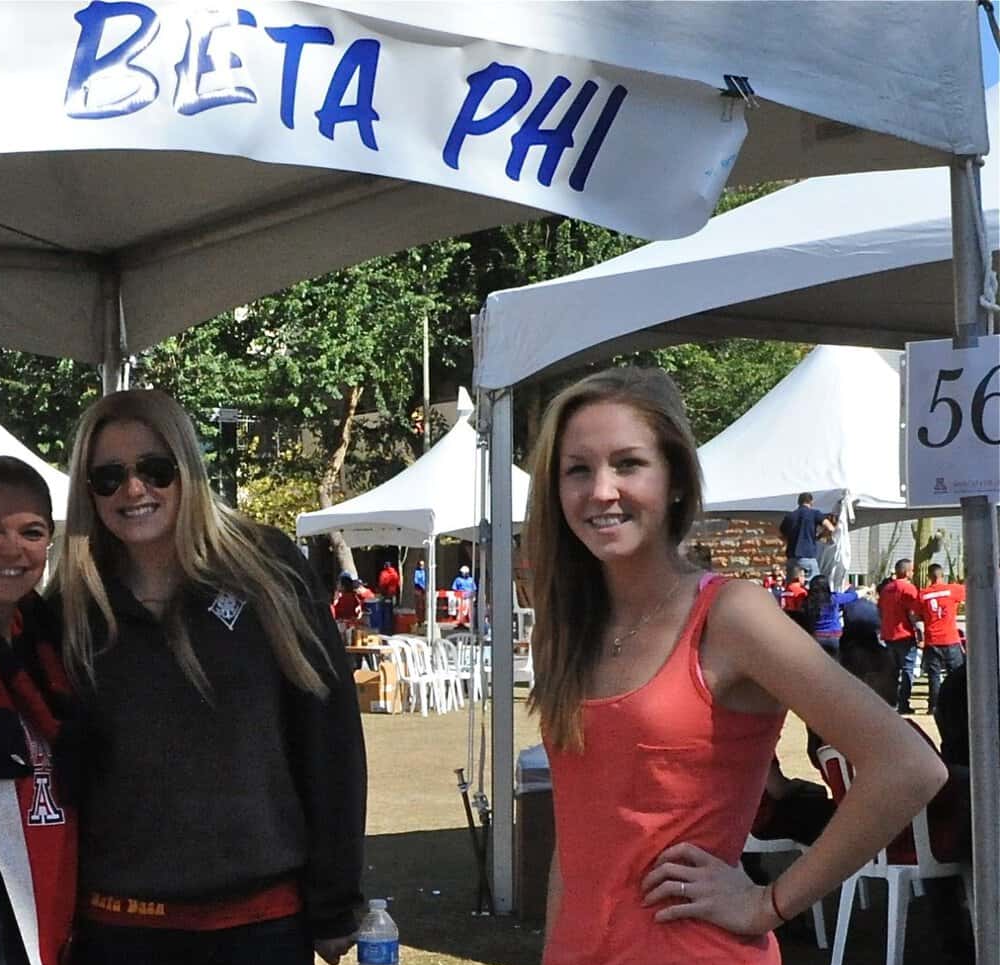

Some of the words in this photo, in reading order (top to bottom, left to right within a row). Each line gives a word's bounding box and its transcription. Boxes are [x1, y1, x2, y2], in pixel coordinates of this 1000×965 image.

[65, 1, 381, 152] BETA
[442, 61, 629, 192] PHI
[917, 364, 1000, 448] 56
